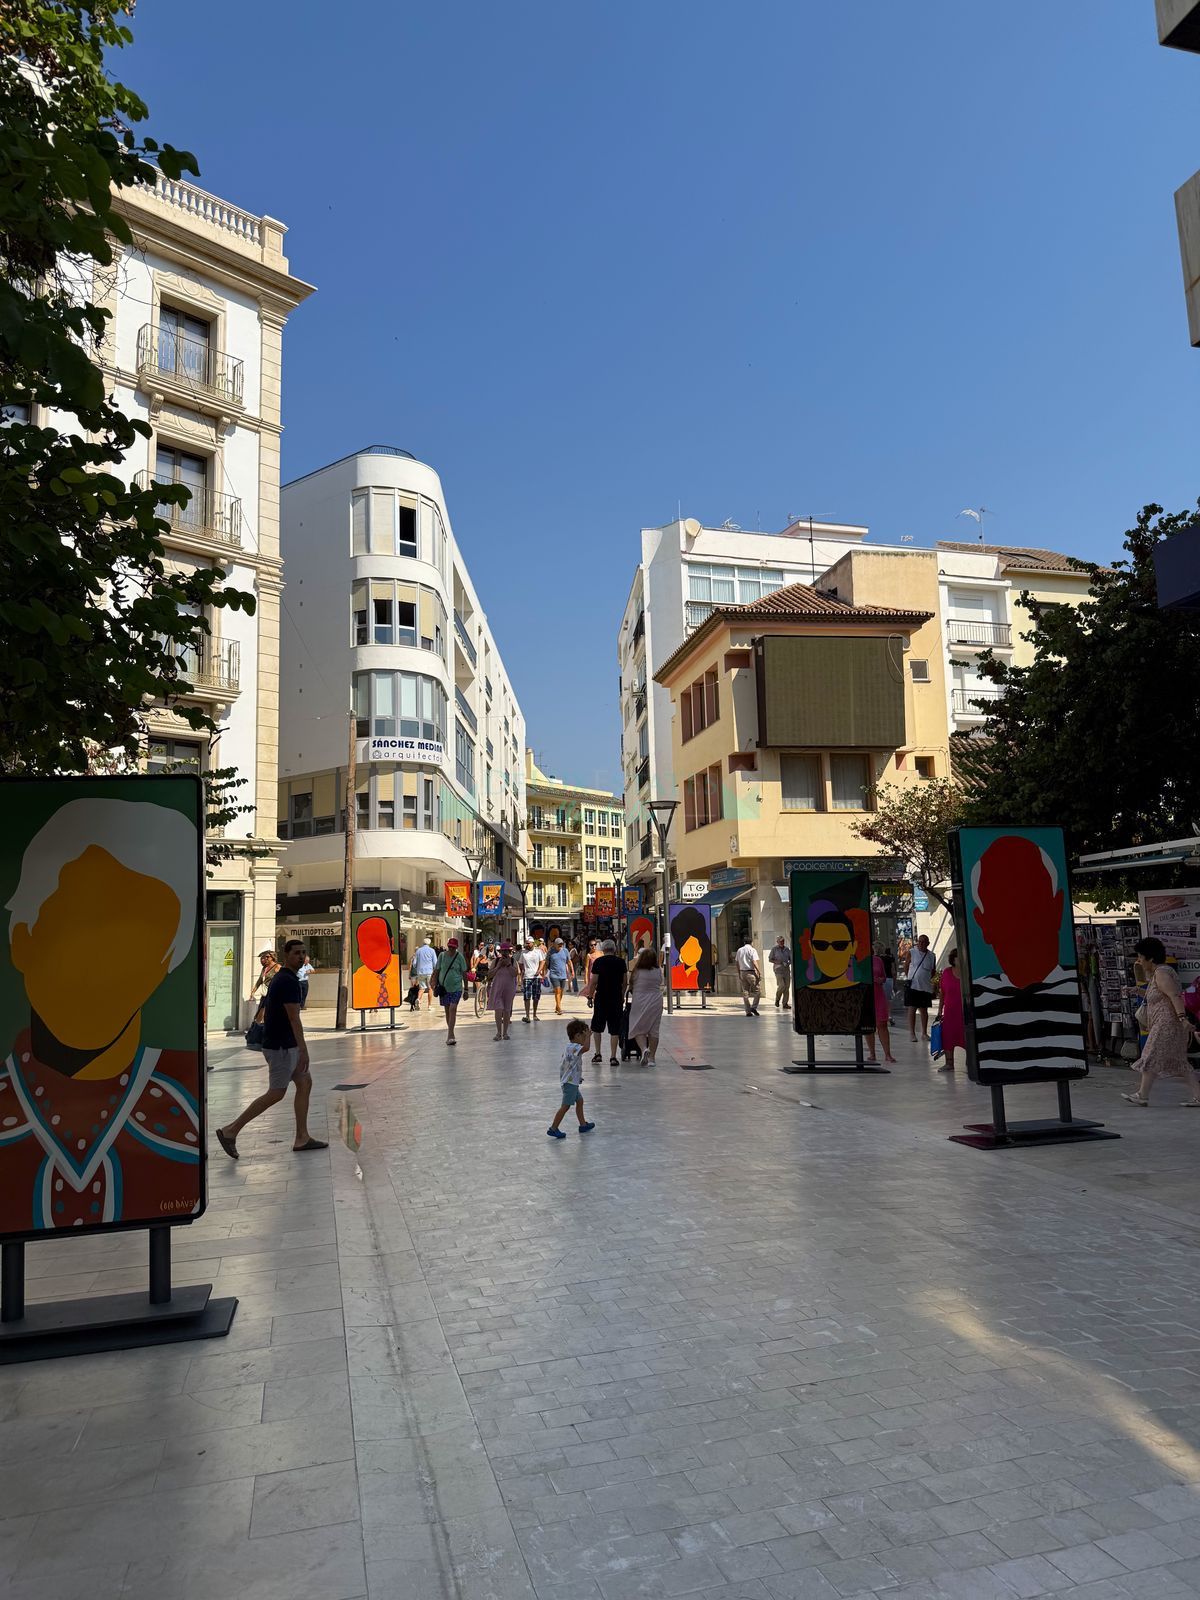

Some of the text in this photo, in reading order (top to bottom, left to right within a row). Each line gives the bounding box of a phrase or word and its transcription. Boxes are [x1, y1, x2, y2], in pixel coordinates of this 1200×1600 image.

[372, 738, 443, 753] SÁNCHEZ MEDINA
[384, 751, 442, 763] arquitectos
[793, 862, 844, 871] copicentro
